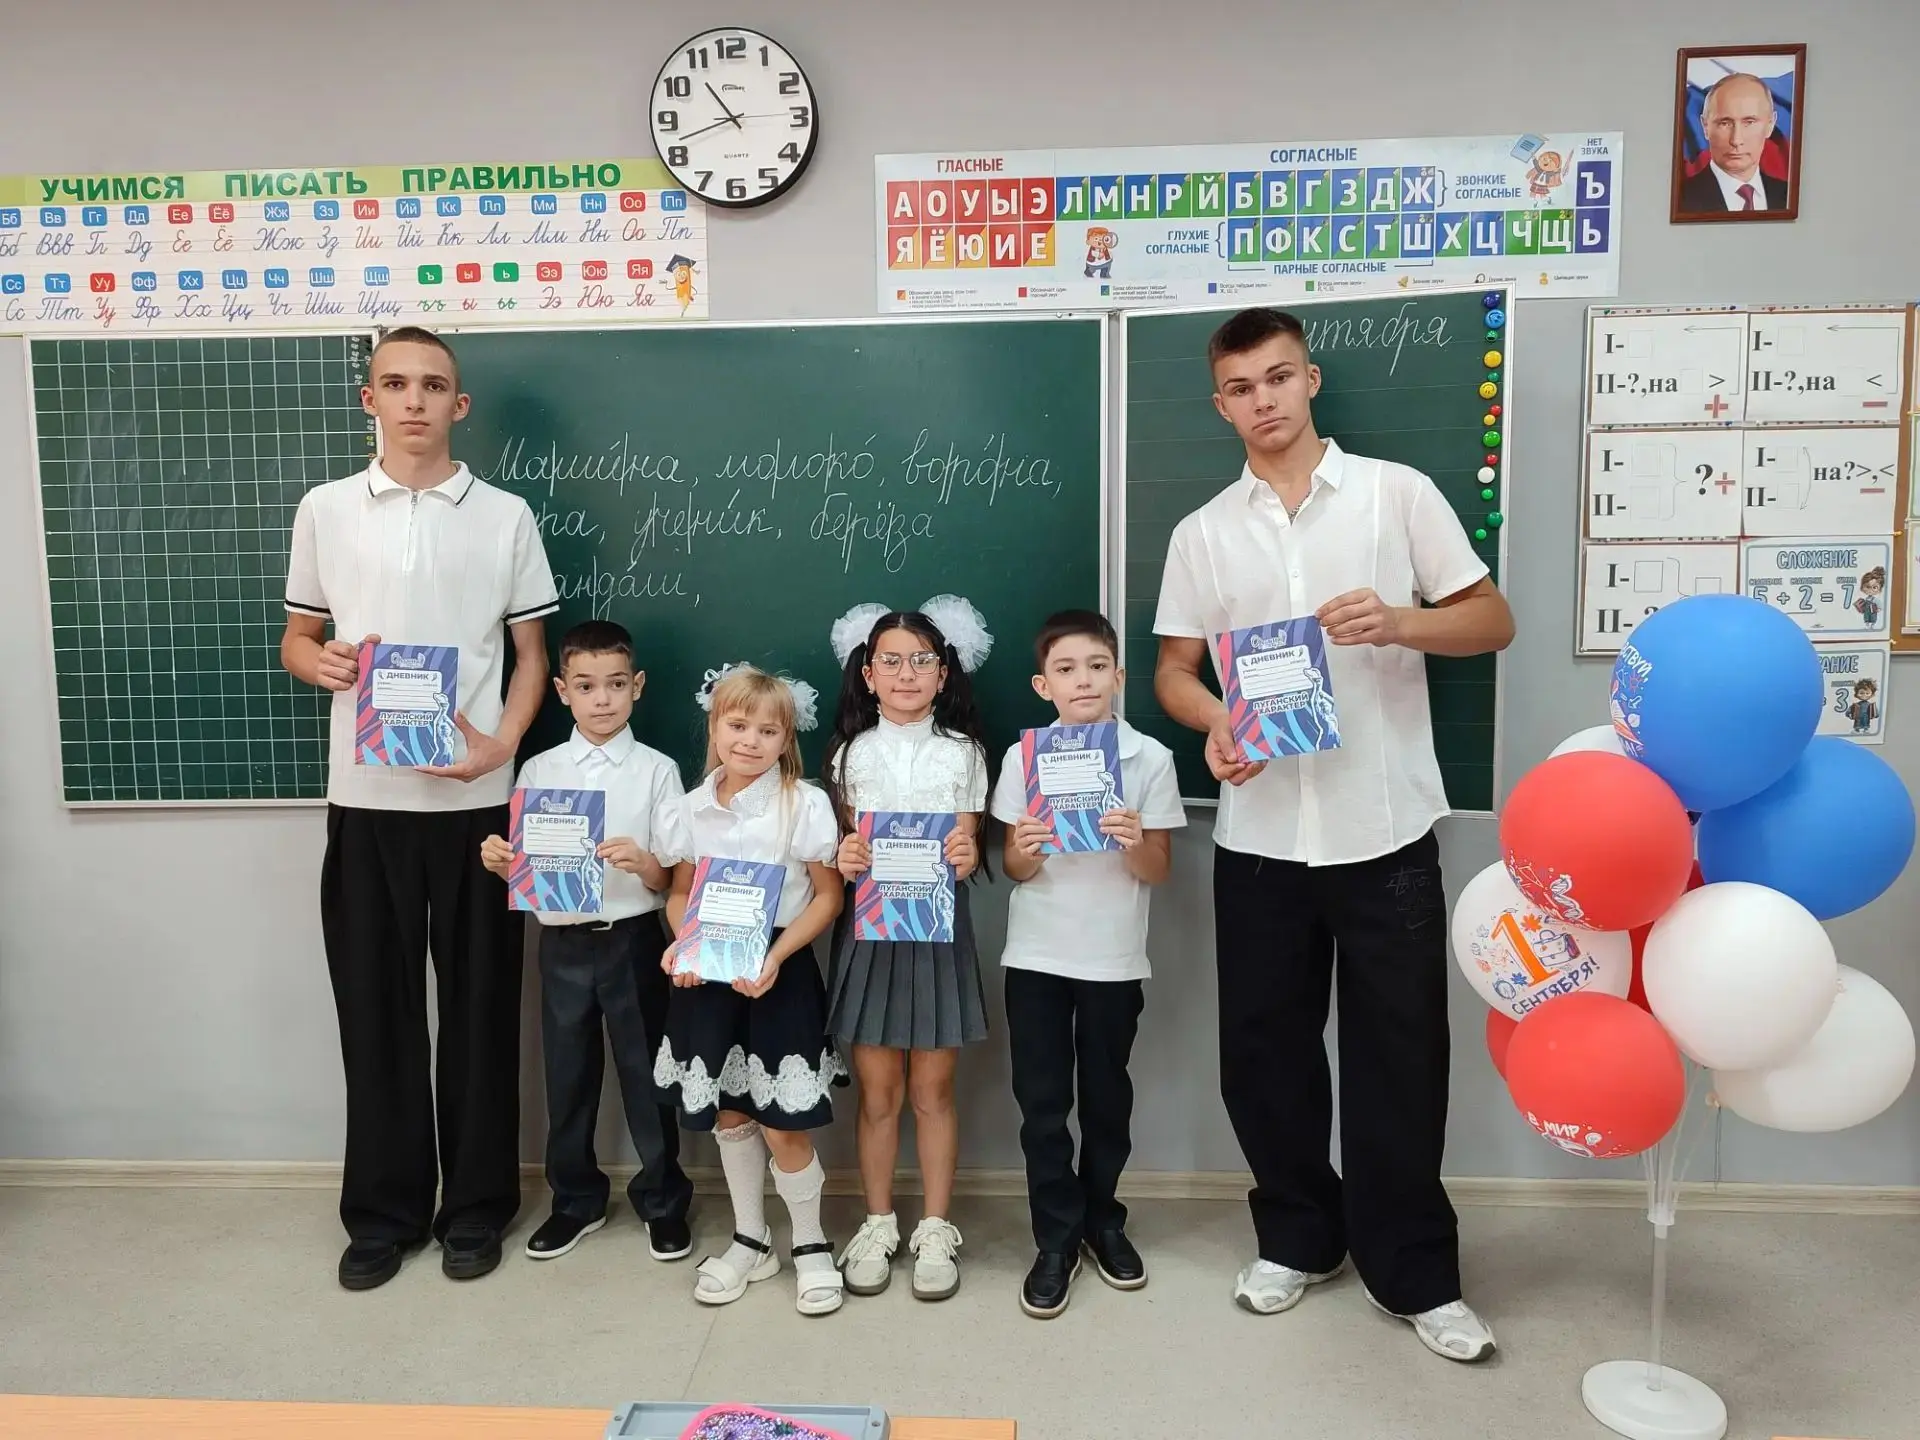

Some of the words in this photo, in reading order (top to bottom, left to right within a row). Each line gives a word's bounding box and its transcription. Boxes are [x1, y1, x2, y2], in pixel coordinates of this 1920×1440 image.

[715, 37, 746, 59] 12
[686, 48, 708, 68] 11
[759, 46, 768, 66] 1
[664, 76, 691, 97] 10
[779, 72, 800, 94] 2
[658, 111, 678, 131] 9
[789, 106, 809, 128] 3
[1587, 138, 1602, 147] НЕТ
[668, 146, 688, 166] 8
[778, 143, 800, 163] 4
[1270, 149, 1357, 163] СОГЛАСНЫЕ
[1581, 147, 1608, 155] ЗВУКА
[937, 158, 1003, 173] ГЛАСНЫЕ
[40, 175, 184, 202] УЧИМСЯ
[225, 171, 368, 198] ПИСАТЬ
[402, 163, 621, 193] ПРАВИЛЬНО
[694, 171, 713, 191] 7
[758, 168, 778, 189] 5
[1455, 174, 1506, 185] ЗВОНКИЕ
[726, 178, 746, 199] 6
[1455, 187, 1521, 198] СОГЛАСНЫЕ
[1168, 230, 1209, 241] ГЛУХИЕ
[1145, 243, 1209, 255] СОГЛАСНЫЕ
[1274, 263, 1318, 275] ПАРНЫЕ
[1322, 262, 1386, 273] СОГЛАСНЫЕ
[1303, 302, 1451, 376] нтября
[1777, 550, 1857, 569] СЛОЖЕНИЕ
[1250, 650, 1295, 665] ДНЕВНИК
[386, 672, 429, 680] ДНЕВНИК
[1254, 693, 1309, 709] ЛУГАНСКИЙ
[1260, 702, 1306, 714] ХАРАКТЕР
[1834, 688, 1849, 713] 3
[380, 712, 433, 721] ЛУГАНСКИЙ
[1050, 754, 1091, 763] ДНЕВНИК
[1049, 796, 1100, 804] ЛУГАНСКИЙ
[1054, 801, 1096, 810] ХАРАКТЕР
[530, 857, 580, 866] ЛУГАНСКИЙ
[716, 886, 754, 896] ДНЕВНИК
[880, 884, 932, 892] ЛУГАНСКИЙ
[1491, 911, 1560, 988] 1
[1511, 956, 1600, 1015] СЕНТЯБРЯ!
